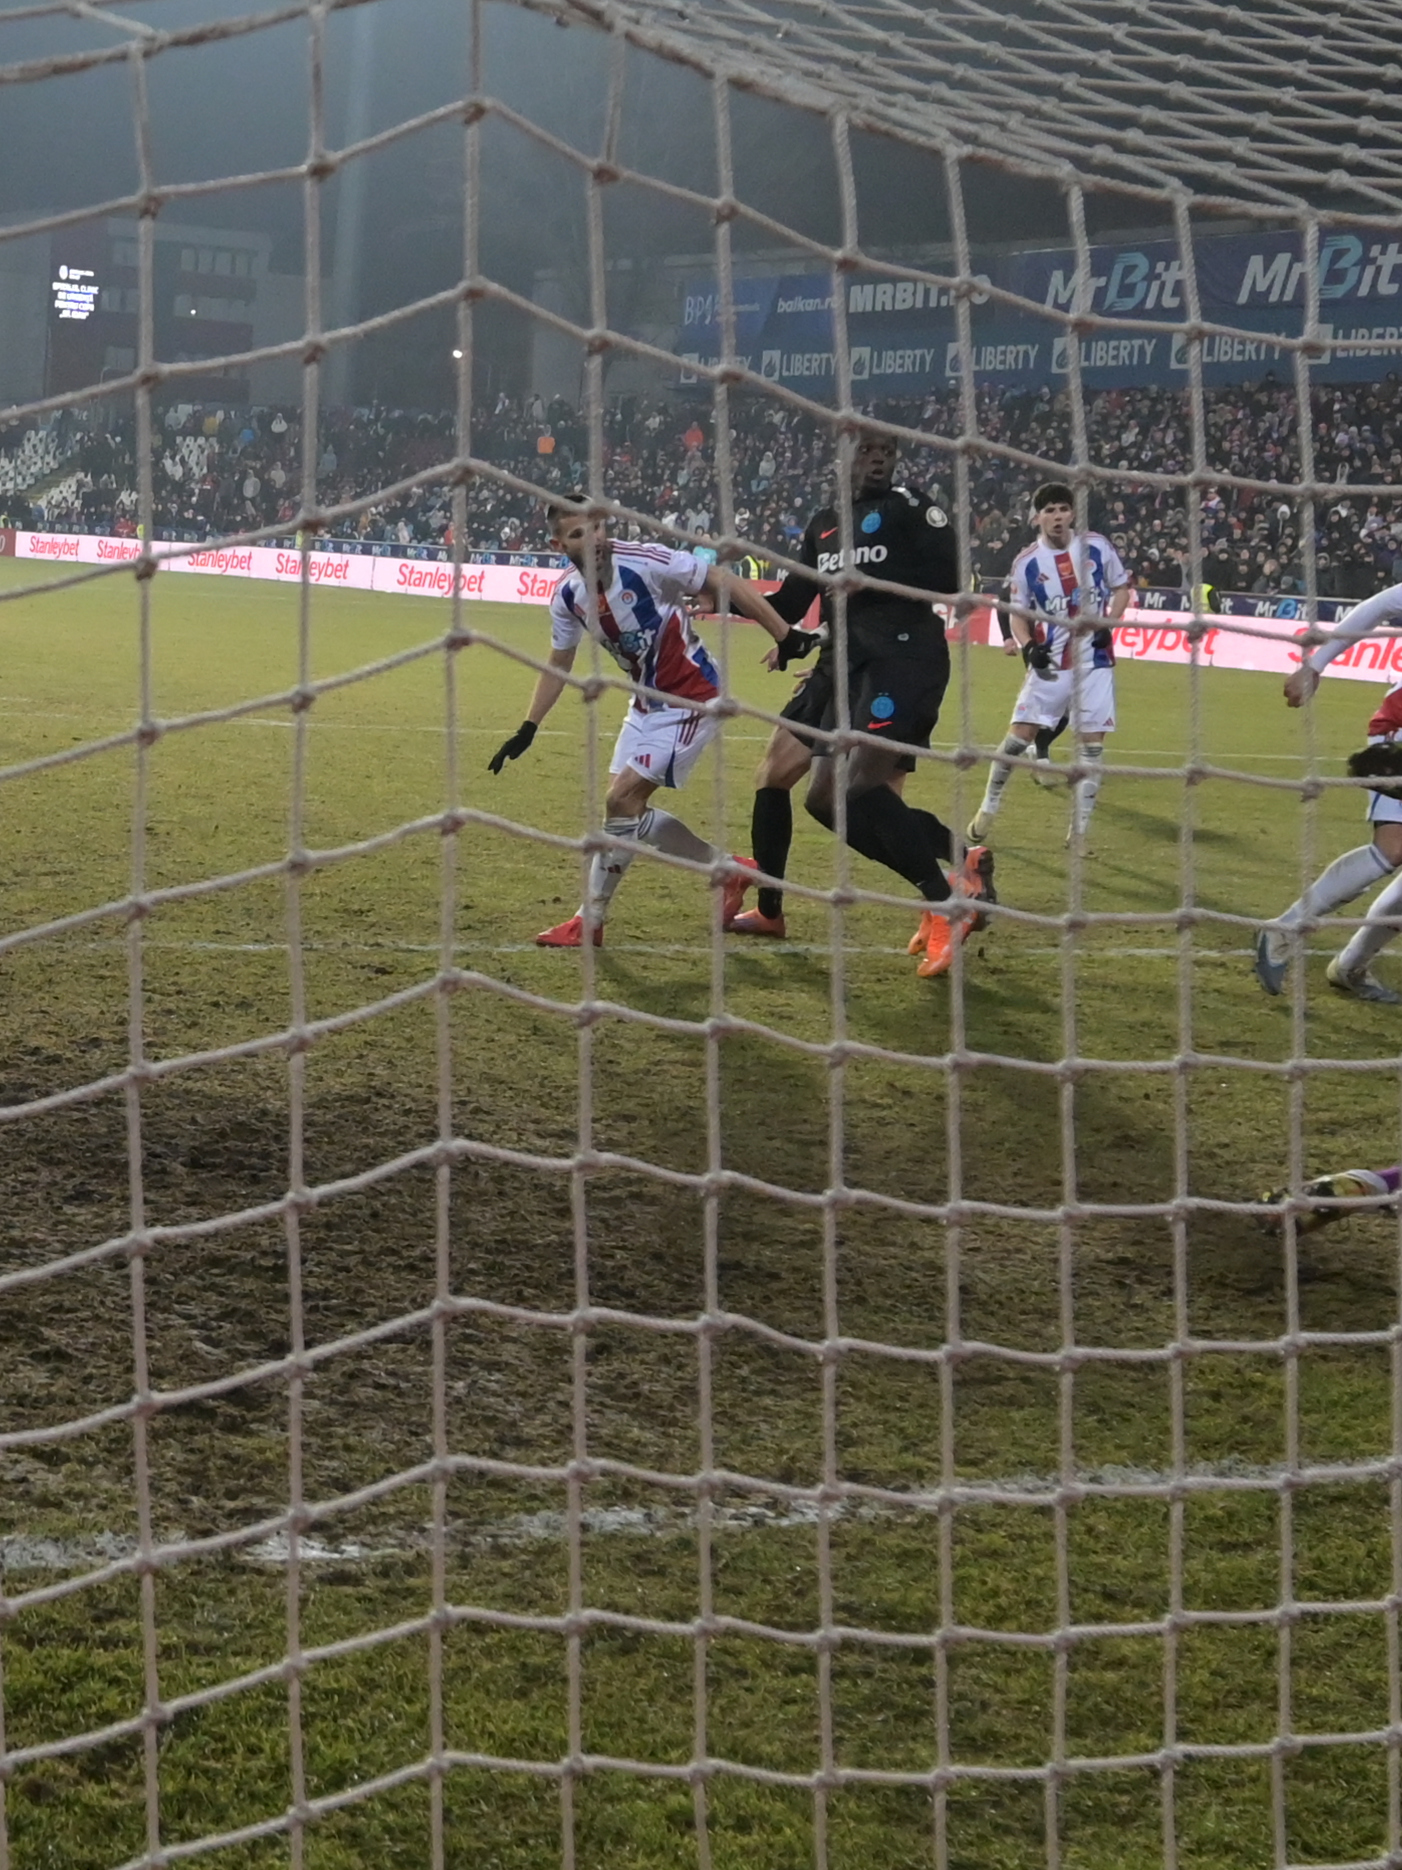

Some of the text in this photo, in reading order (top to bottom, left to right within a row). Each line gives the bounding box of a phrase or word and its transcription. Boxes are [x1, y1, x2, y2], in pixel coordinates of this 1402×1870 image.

[849, 274, 993, 313] MRBIT.O
[871, 348, 935, 374] LIBERTY
[972, 344, 1039, 371] LIBERTY
[1080, 338, 1157, 367] LIBERTY
[1202, 331, 1286, 363] LIBERTY
[782, 353, 838, 376] LIBERTY
[29, 535, 80, 559] Stanleybet
[276, 553, 349, 582] Staleybet
